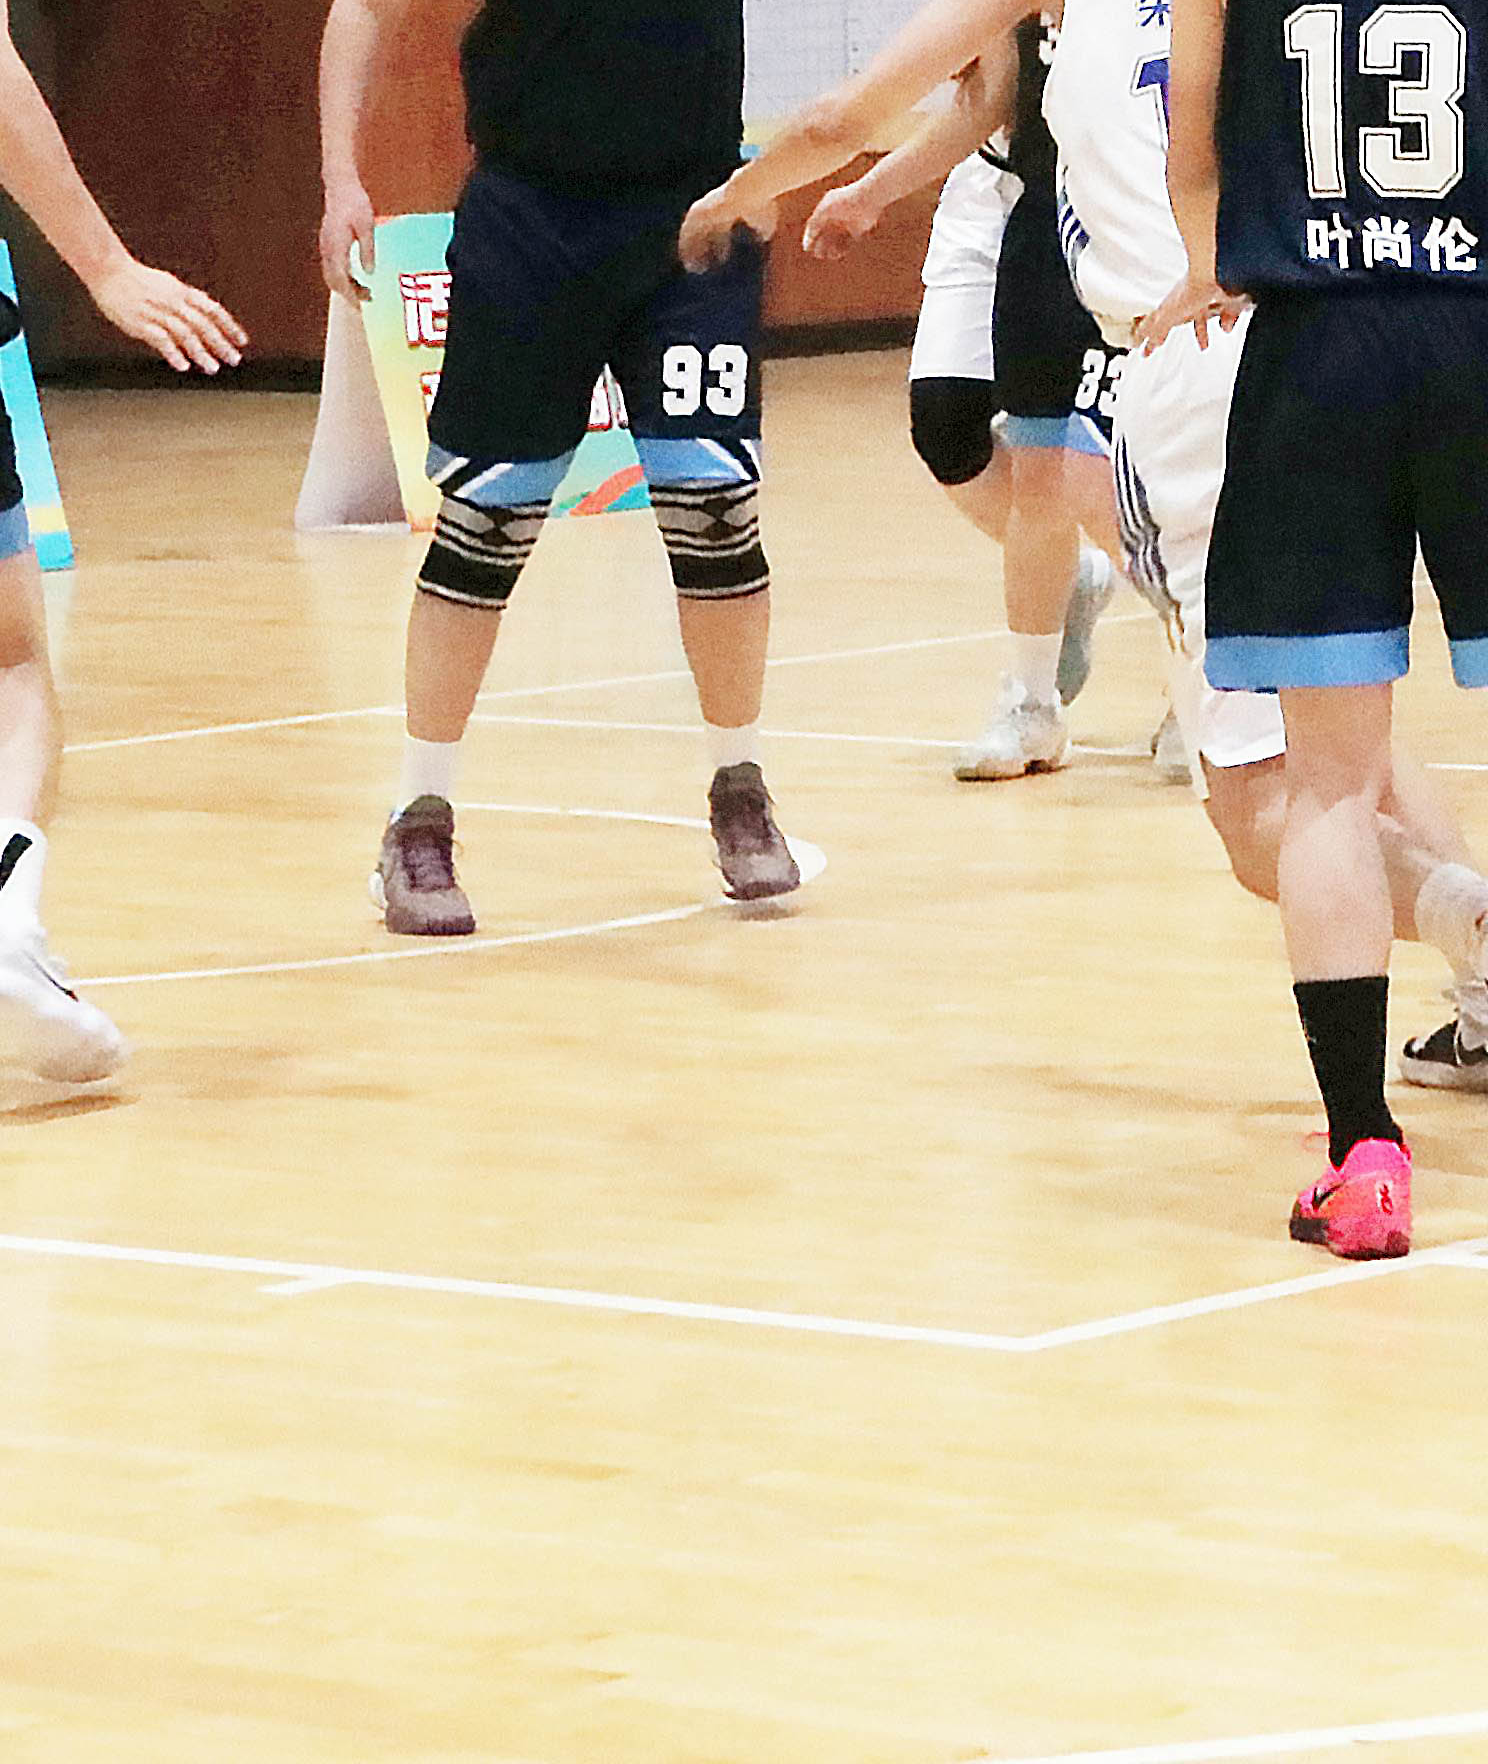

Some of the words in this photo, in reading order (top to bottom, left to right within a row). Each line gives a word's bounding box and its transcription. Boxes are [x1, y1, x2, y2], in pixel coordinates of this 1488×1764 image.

[1283, 3, 1467, 200] 13
[1305, 212, 1479, 272] 叶尚伦
[662, 343, 749, 417] 93
